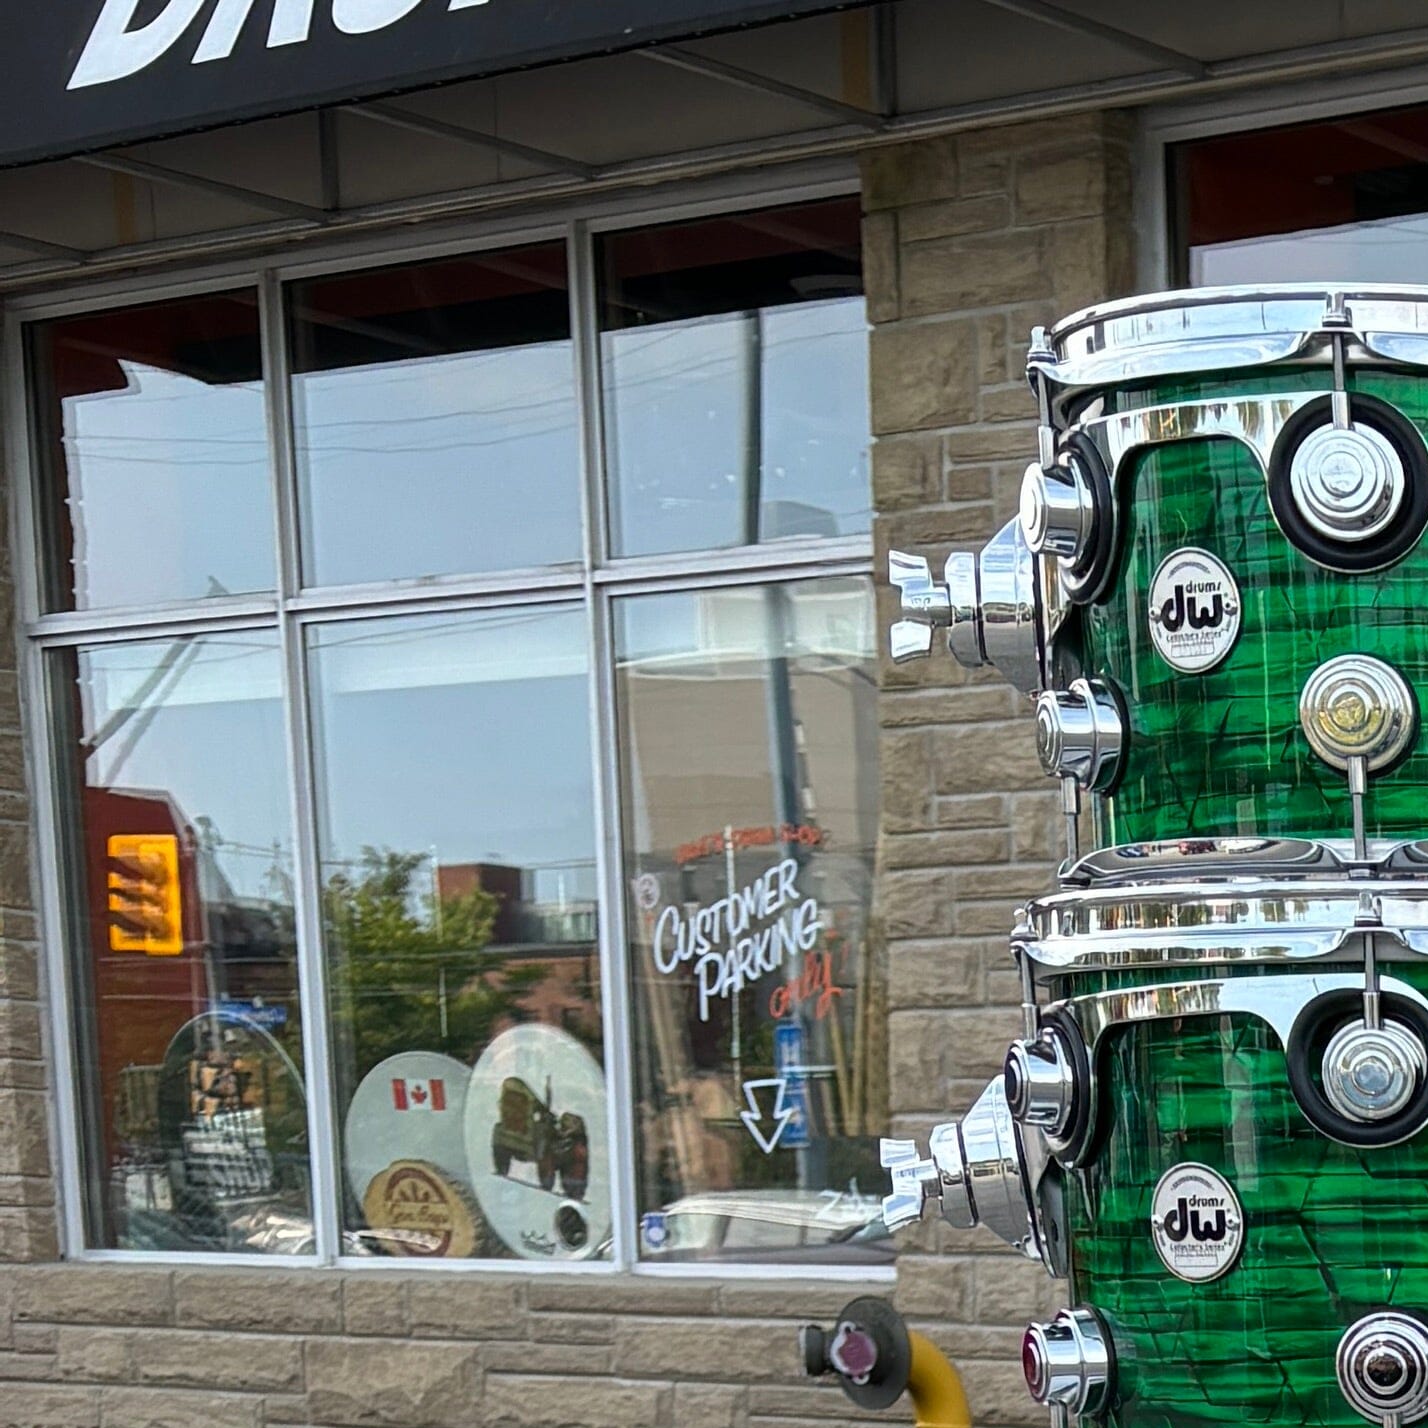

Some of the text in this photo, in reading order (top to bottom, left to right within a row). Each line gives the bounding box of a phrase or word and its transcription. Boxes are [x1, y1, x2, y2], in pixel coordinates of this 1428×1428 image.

[1160, 584, 1223, 632] dw
[654, 858, 800, 974] CUSTOMER
[694, 899, 824, 1021] PARKING
[1164, 1198, 1225, 1242] dw
